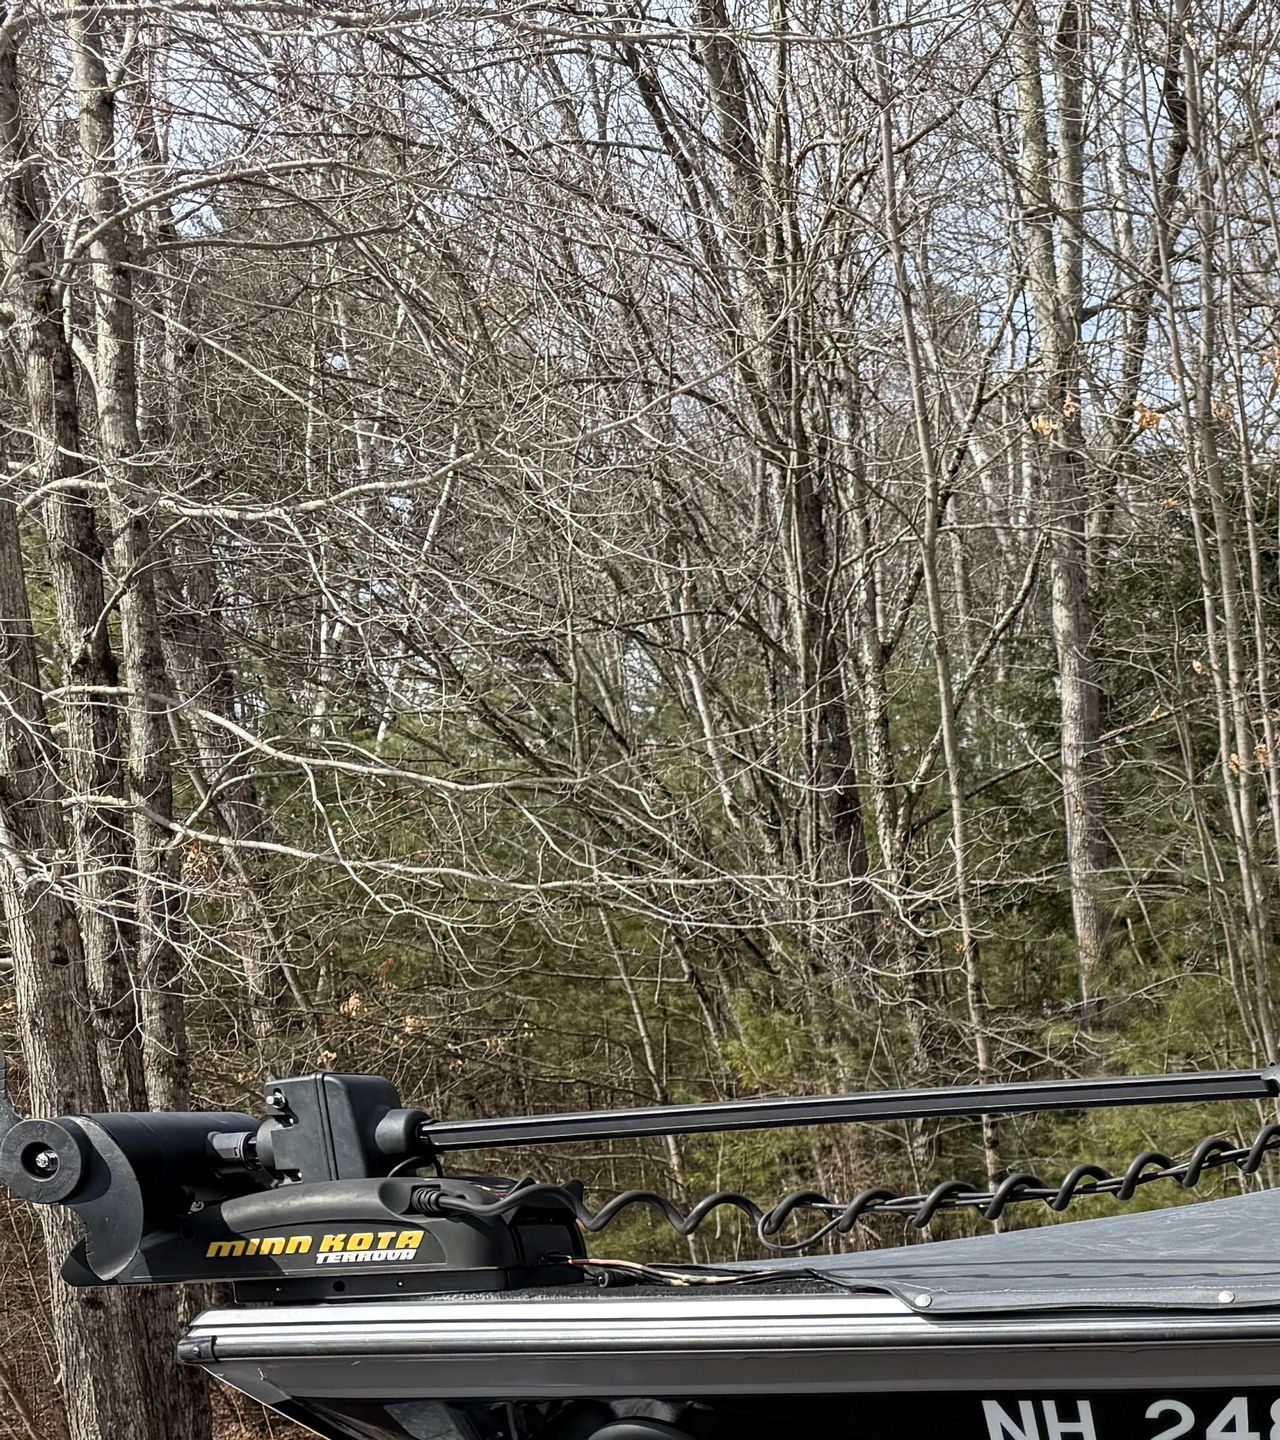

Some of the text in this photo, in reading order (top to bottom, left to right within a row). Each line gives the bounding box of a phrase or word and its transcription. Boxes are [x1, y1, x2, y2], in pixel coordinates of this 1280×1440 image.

[205, 1230, 425, 1258] MINN KOTA
[315, 1248, 417, 1265] TERROVA
